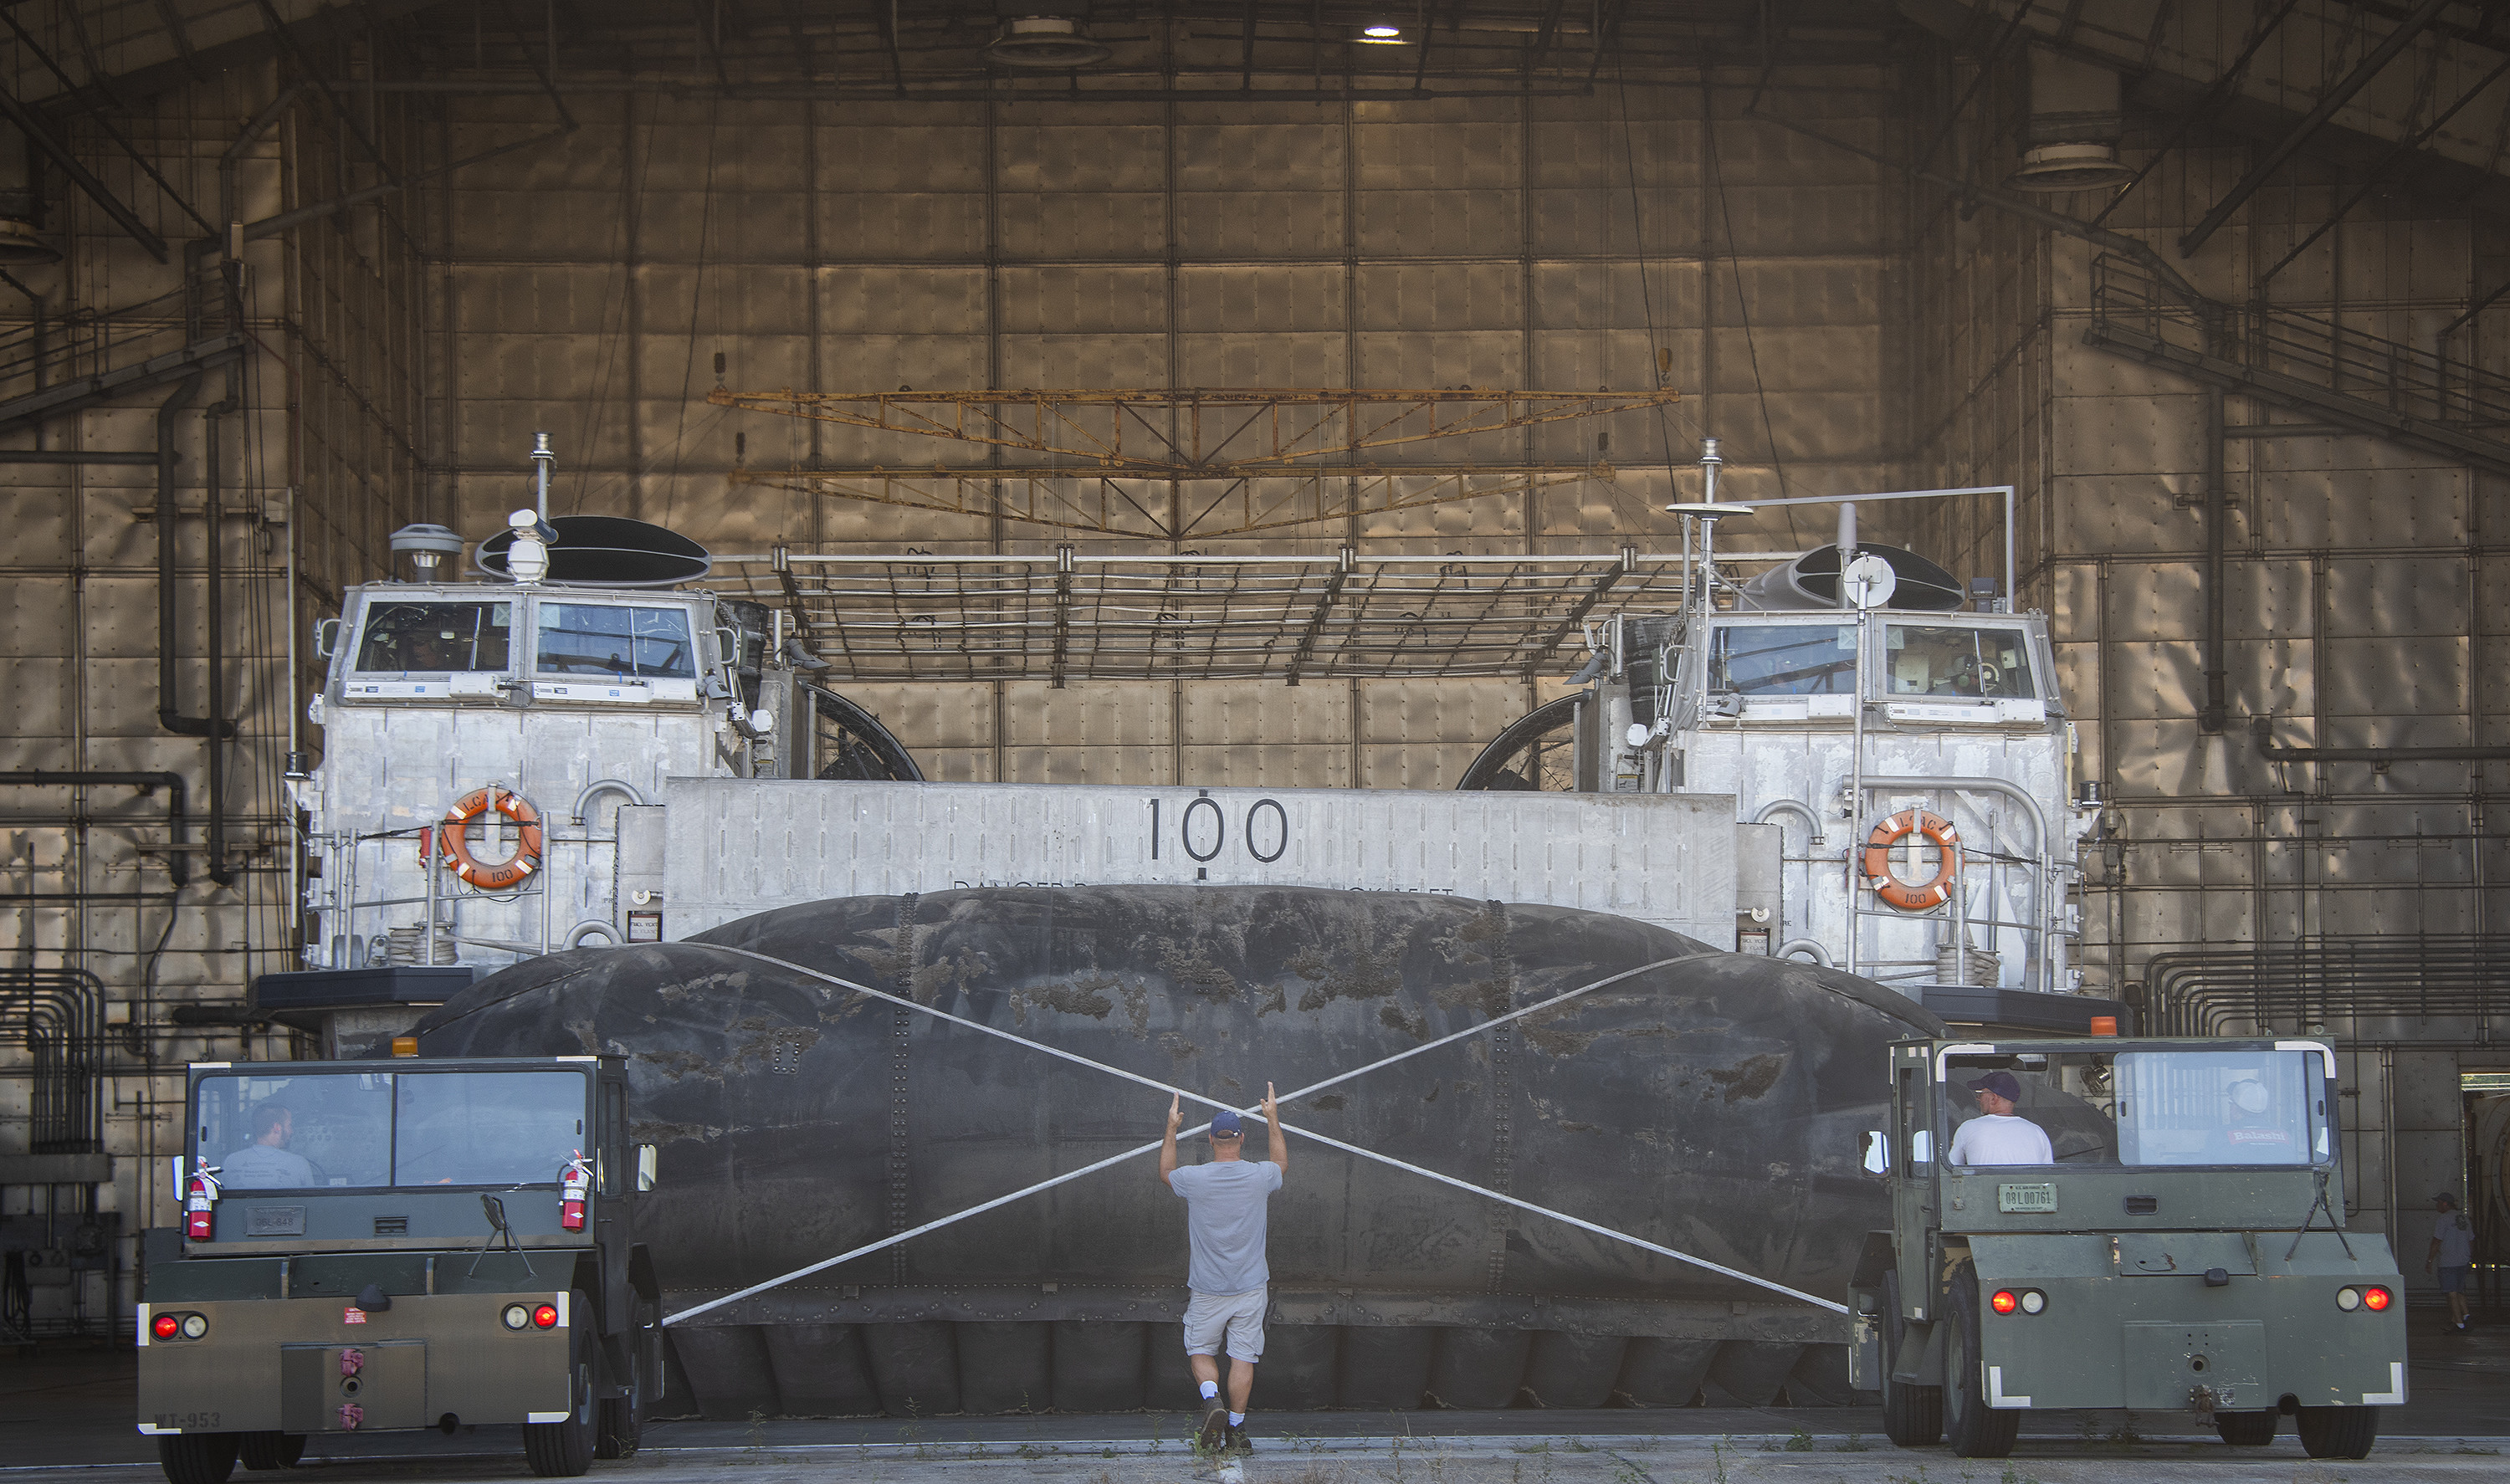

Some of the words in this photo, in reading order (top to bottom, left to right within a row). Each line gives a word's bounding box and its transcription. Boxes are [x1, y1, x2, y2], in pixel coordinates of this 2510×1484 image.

[1150, 797, 1288, 863] 100
[492, 869, 514, 883] 100
[1905, 893, 1927, 904] 100
